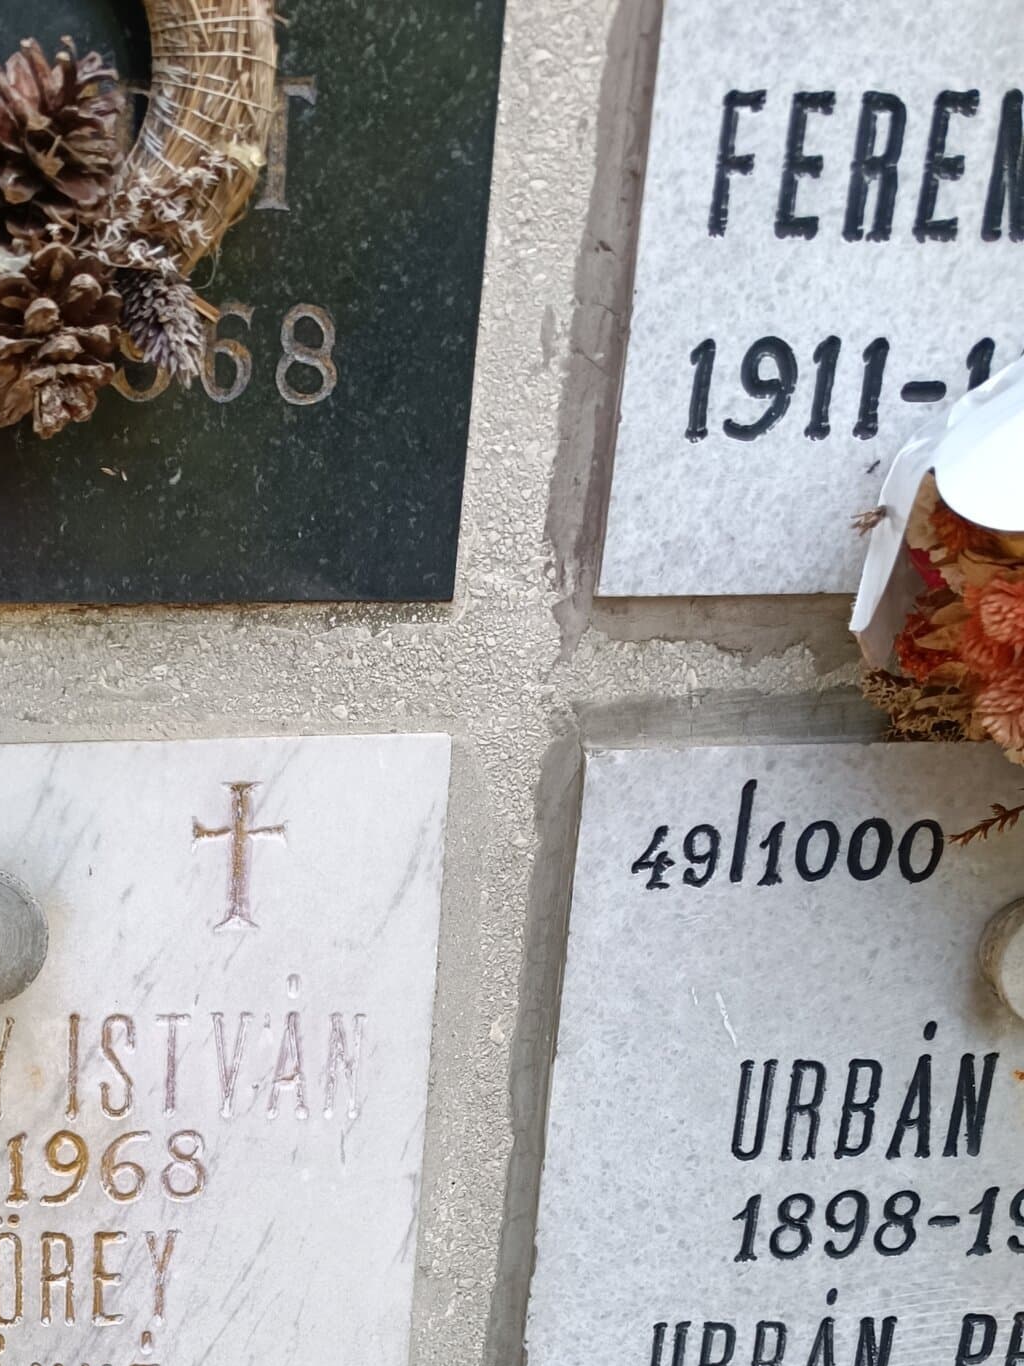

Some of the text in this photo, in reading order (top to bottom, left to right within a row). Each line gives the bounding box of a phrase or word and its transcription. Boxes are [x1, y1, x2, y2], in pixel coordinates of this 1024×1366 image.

[684, 335, 1024, 443] 1911-1
[65, 973, 369, 1121] ISTVÁN
[729, 1020, 1001, 1163] URBÁN
